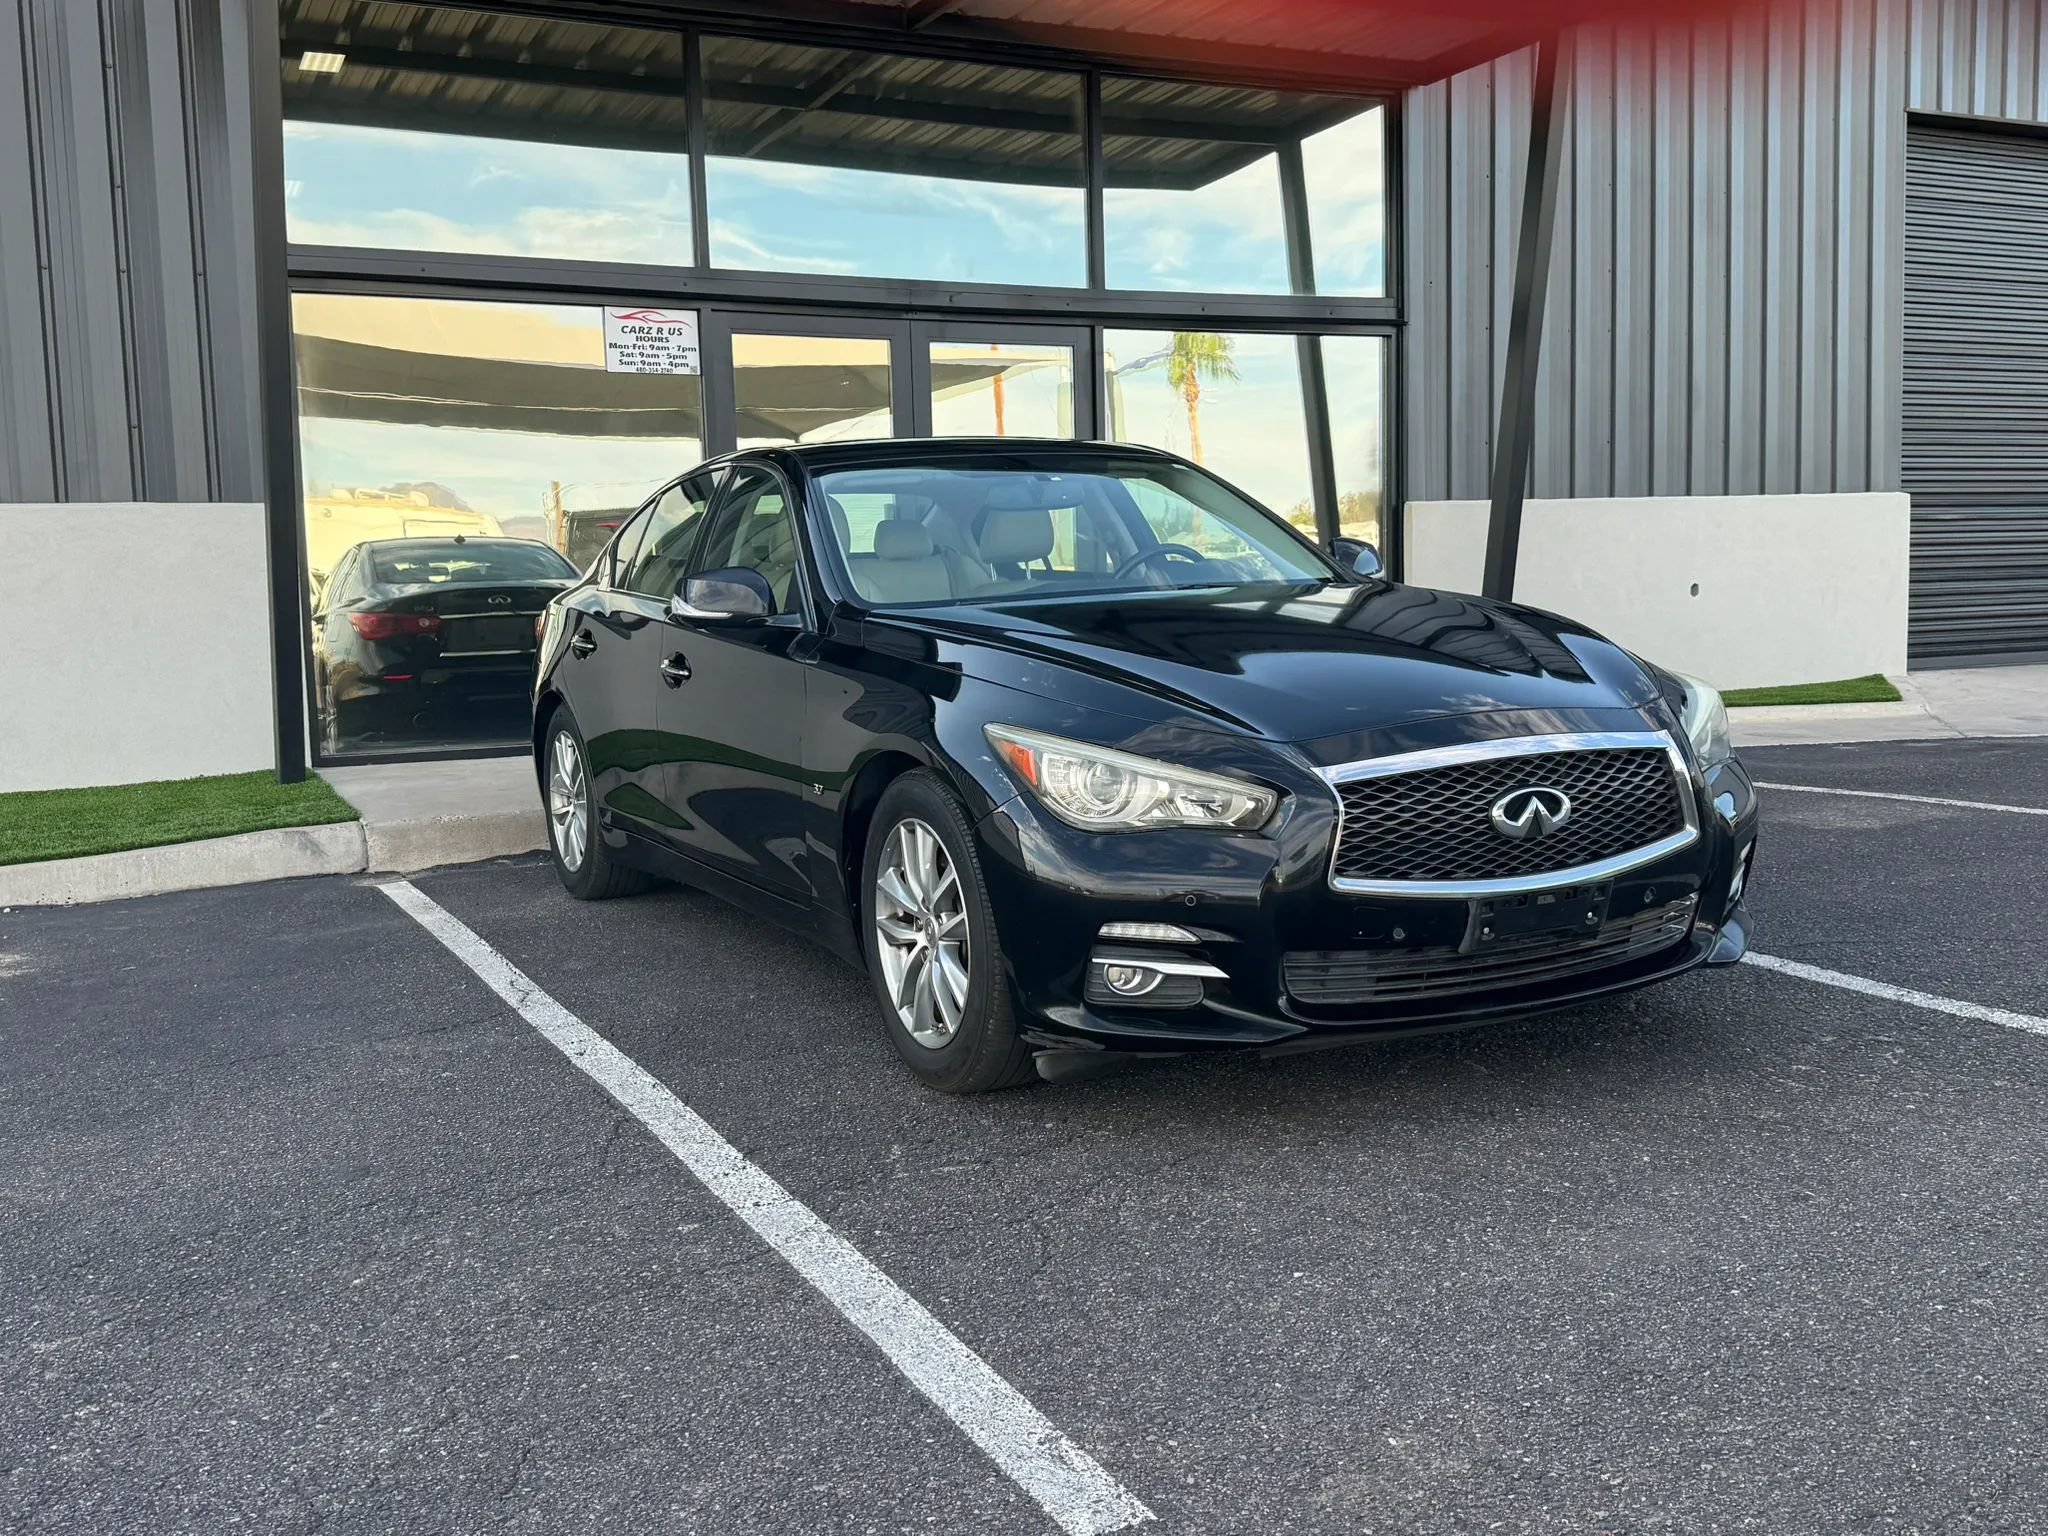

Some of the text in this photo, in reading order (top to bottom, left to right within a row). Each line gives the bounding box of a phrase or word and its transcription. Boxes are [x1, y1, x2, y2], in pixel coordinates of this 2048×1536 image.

[621, 326, 683, 336] CARZ R US
[609, 342, 648, 350] Mon-Fri:
[676, 345, 696, 353] 7pm
